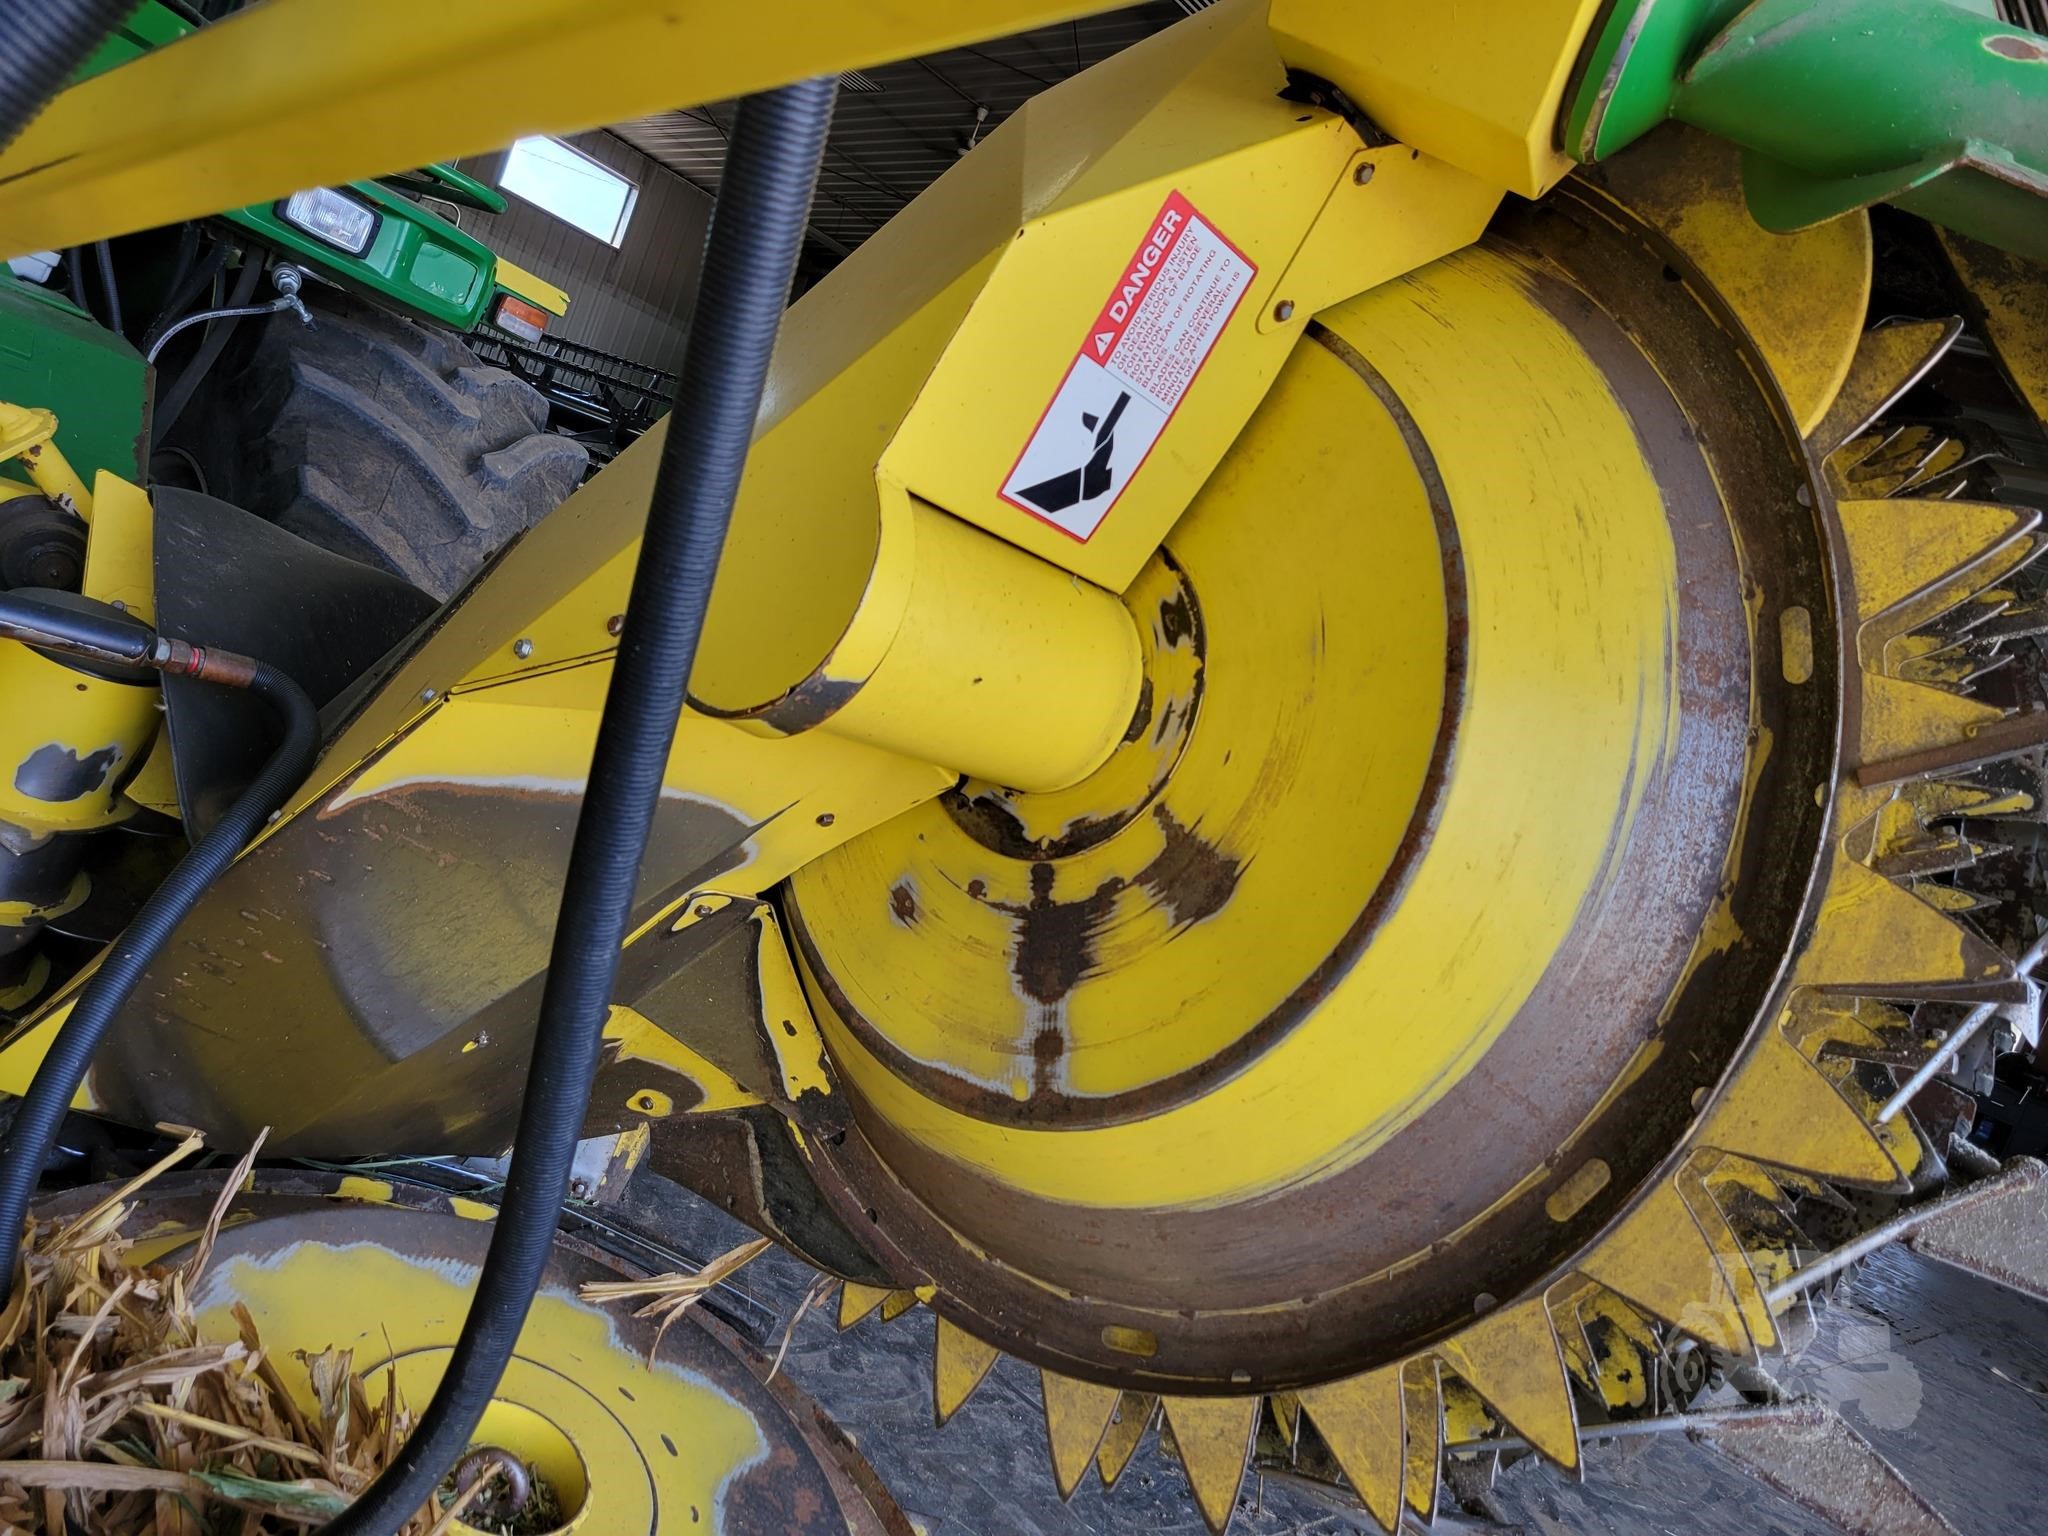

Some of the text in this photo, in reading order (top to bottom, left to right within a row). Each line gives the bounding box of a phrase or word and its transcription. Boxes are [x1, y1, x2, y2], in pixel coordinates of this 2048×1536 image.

[1107, 205, 1182, 324] DANGER
[1110, 225, 1194, 366] TO AVOID SERIOUS INJURY
[1116, 234, 1197, 370] OR DEATH LOOK & LISTEN
[1122, 244, 1201, 375] FOR EVIDENCE OF BLADE
[1134, 247, 1217, 384] STAY CLEAR OF ROTATING
[1148, 257, 1231, 393] BLADES CAN CONTINUE TO
[1128, 322, 1165, 379] ROTATION.
[1154, 286, 1222, 398] ROTATE FOR SEVERAL
[1160, 270, 1240, 402] MINUTES AFTER POWER IS
[1165, 378, 1185, 406] SHUT
